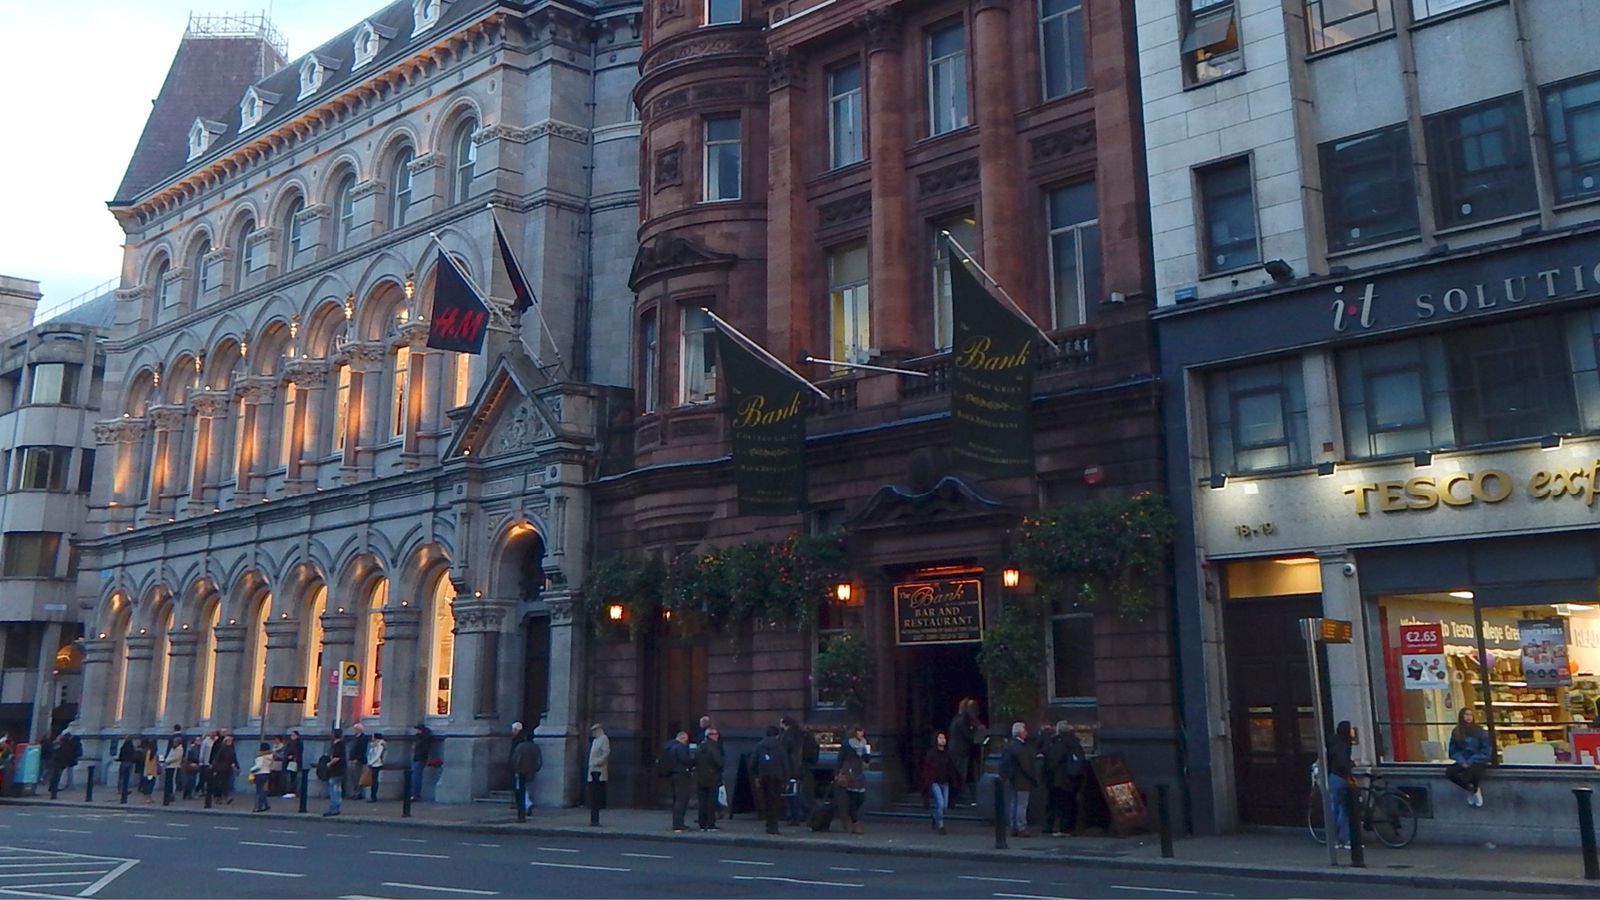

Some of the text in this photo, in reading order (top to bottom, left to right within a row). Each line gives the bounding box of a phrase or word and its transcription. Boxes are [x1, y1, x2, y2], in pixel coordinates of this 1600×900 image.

[955, 335, 1031, 371] Bank
[732, 391, 801, 427] Bank
[1343, 468, 1513, 515] TESCO
[910, 583, 964, 608] Bank
[904, 616, 972, 627] RESTAURANT
[915, 606, 960, 617] BAR AND
[1406, 631, 1437, 642] €2.65
[1450, 621, 1474, 639] Tesco
